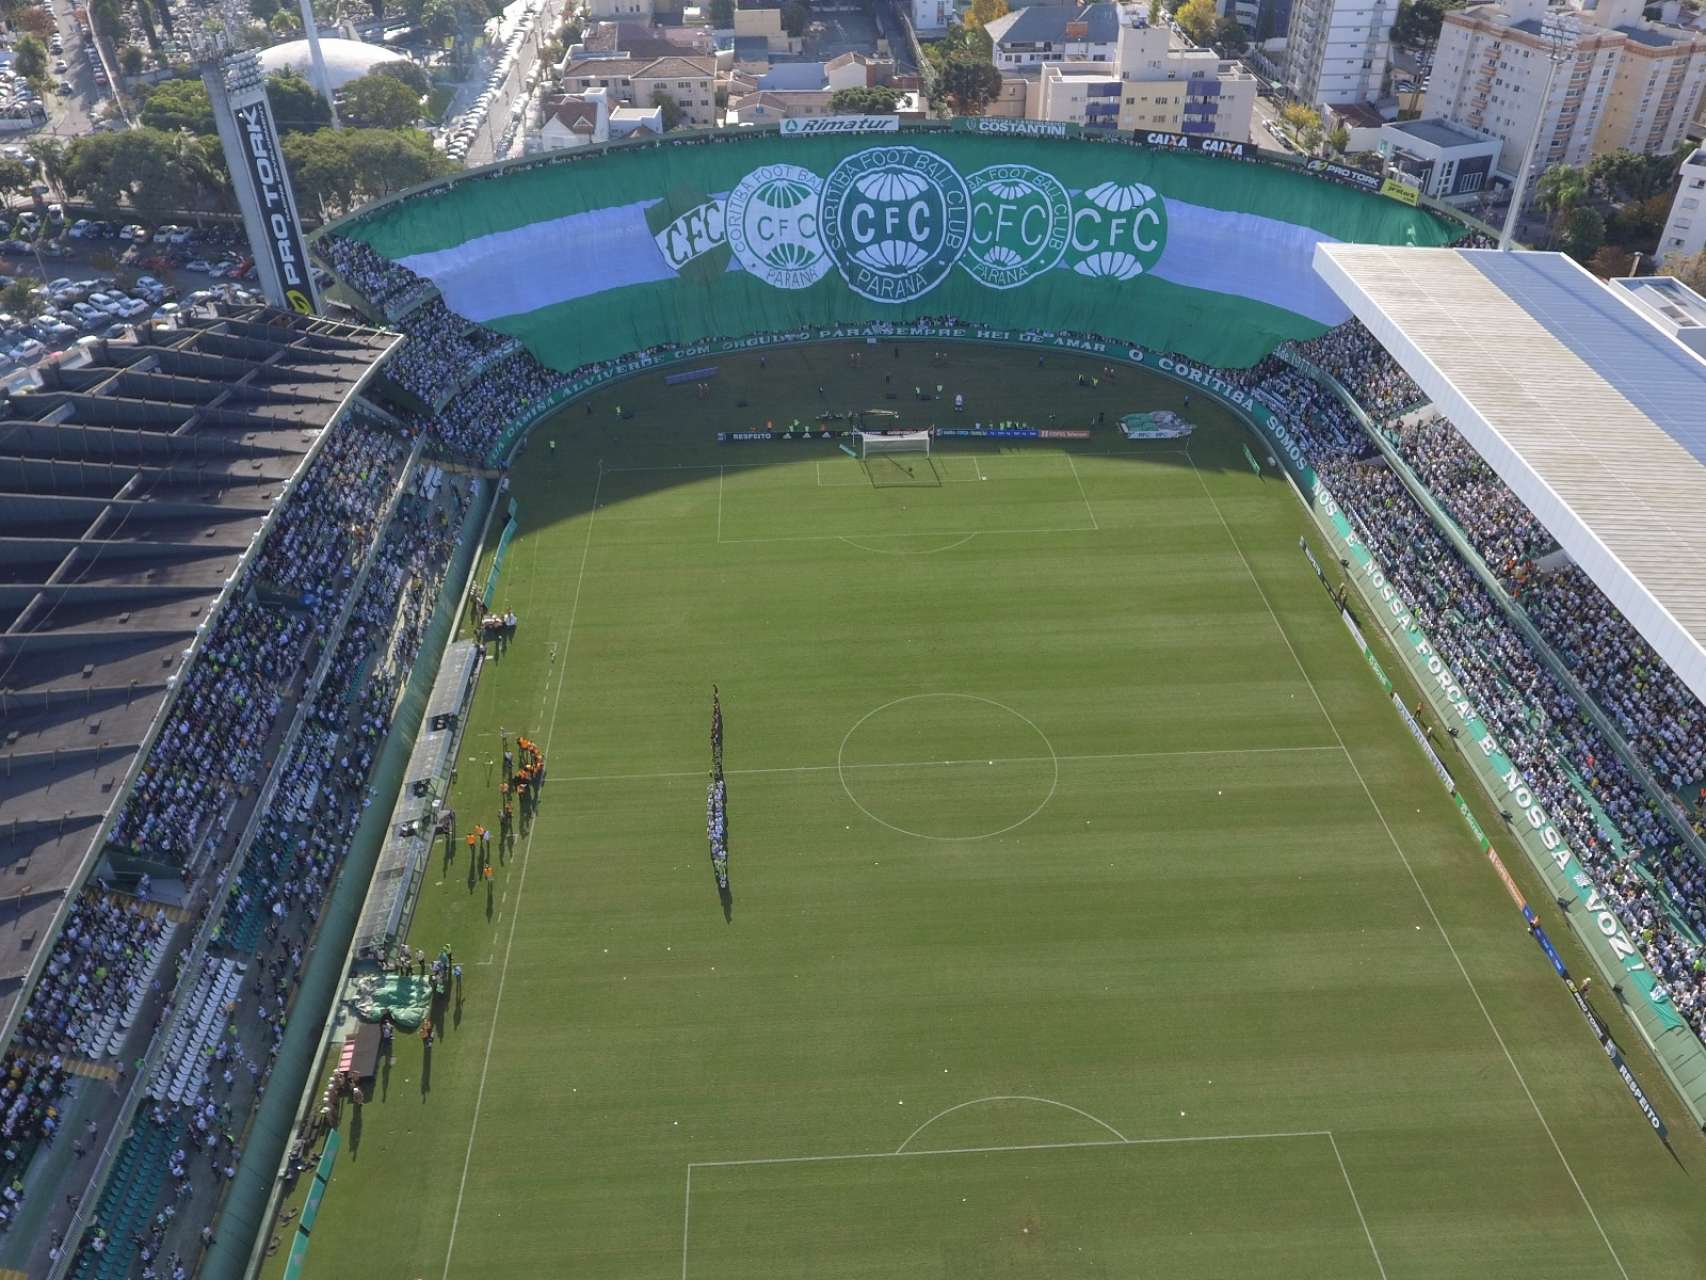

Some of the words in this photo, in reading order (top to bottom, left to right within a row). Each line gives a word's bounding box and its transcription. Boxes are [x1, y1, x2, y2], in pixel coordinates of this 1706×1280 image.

[801, 117, 894, 132] Rimatur
[980, 121, 1066, 136] COSTANTINI
[1147, 132, 1188, 148] CAIXA
[247, 107, 279, 208] TORK
[1202, 138, 1243, 156] CAIXA
[1327, 165, 1350, 178] PRO
[1352, 171, 1380, 187] TORK
[728, 182, 753, 253] CORITIBA
[752, 165, 795, 184] FOOT
[825, 165, 860, 250] CORITIBA
[860, 150, 913, 169] FOOT
[914, 154, 953, 188] BALL
[945, 190, 966, 249] CLUB
[851, 200, 931, 244] CFC
[988, 167, 1031, 181] FOOT
[1032, 172, 1062, 203] BALL
[1049, 203, 1068, 250] CLUB
[666, 202, 724, 265] CFC
[757, 214, 817, 241] CFC
[972, 202, 1047, 246] CFC
[1072, 207, 1160, 252] CFC
[271, 213, 300, 286] PRO
[674, 344, 711, 359] COM
[976, 330, 1010, 340] HEI
[1019, 333, 1044, 344] DE
[1053, 337, 1106, 352] AMAR
[1128, 349, 1145, 362] O
[1157, 357, 1255, 413] CORITIBA
[1265, 415, 1307, 471] SOMOS
[1363, 559, 1412, 631] NOSSA
[1501, 766, 1572, 871] NOSSA
[1573, 990, 1588, 1012] PRO
[1618, 1063, 1661, 1130] RESPEITO
